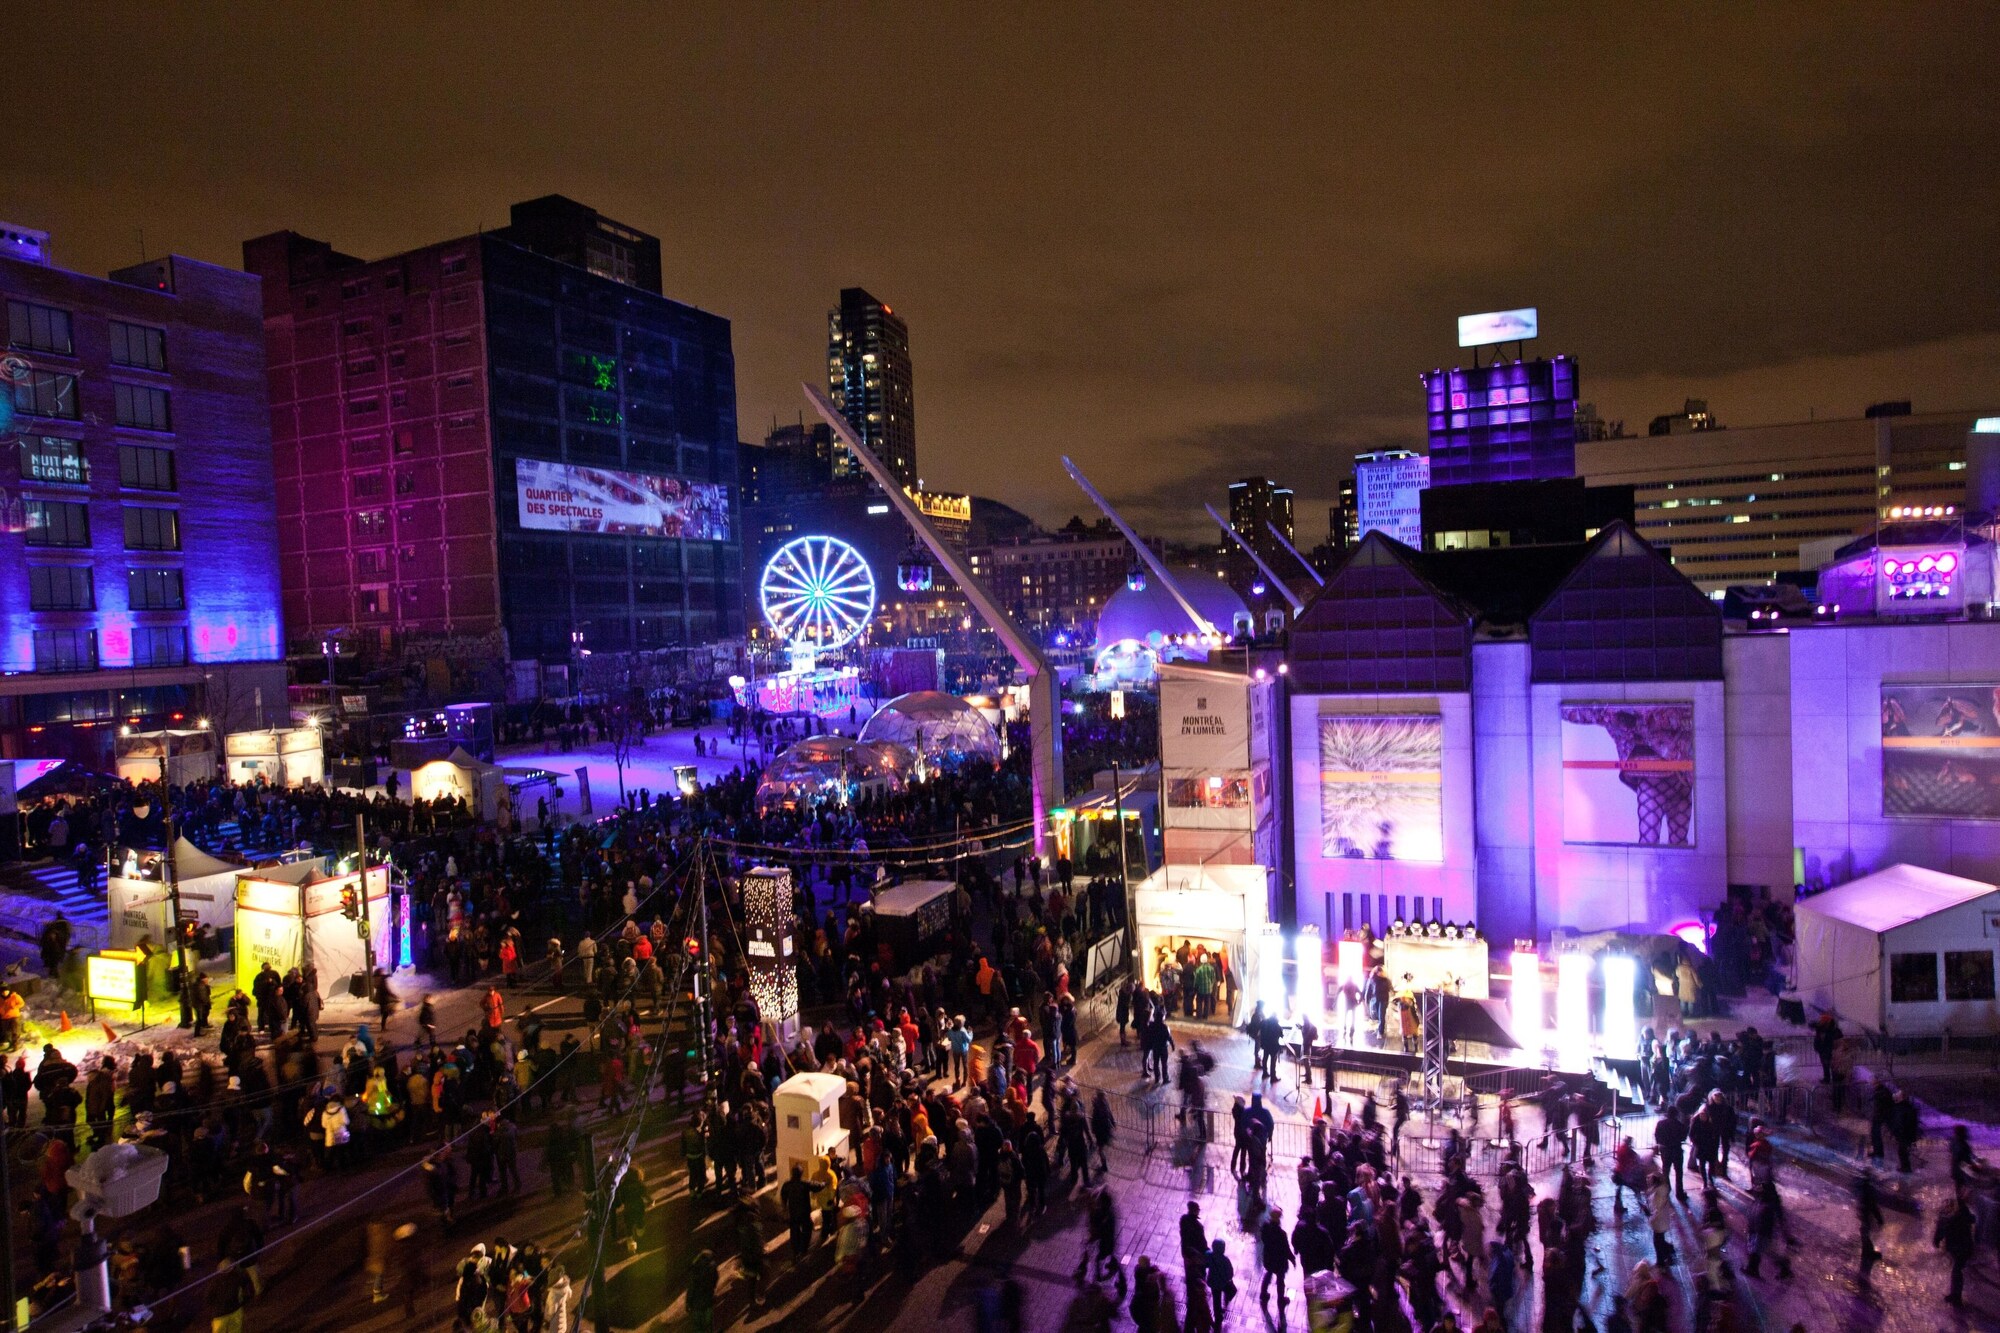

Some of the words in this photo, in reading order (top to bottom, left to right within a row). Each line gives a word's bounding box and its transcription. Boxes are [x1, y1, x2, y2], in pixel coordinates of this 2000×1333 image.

[31, 454, 60, 467] NUIT
[32, 465, 92, 481] BLANCHE
[1368, 473, 1391, 482] D'ART
[1368, 480, 1429, 491] CONTEMPORAIN
[526, 488, 574, 502] QUARTIER
[1368, 490, 1394, 500] MUSÉE
[527, 502, 546, 514] DES
[548, 504, 604, 518] SPECTACLES
[1369, 501, 1391, 509] D'ART
[1182, 715, 1224, 726] MONTRÉAL
[1181, 726, 1191, 735] EN
[1192, 726, 1227, 735] LUMIÈRE
[252, 943, 280, 957] MONTRÉAL
